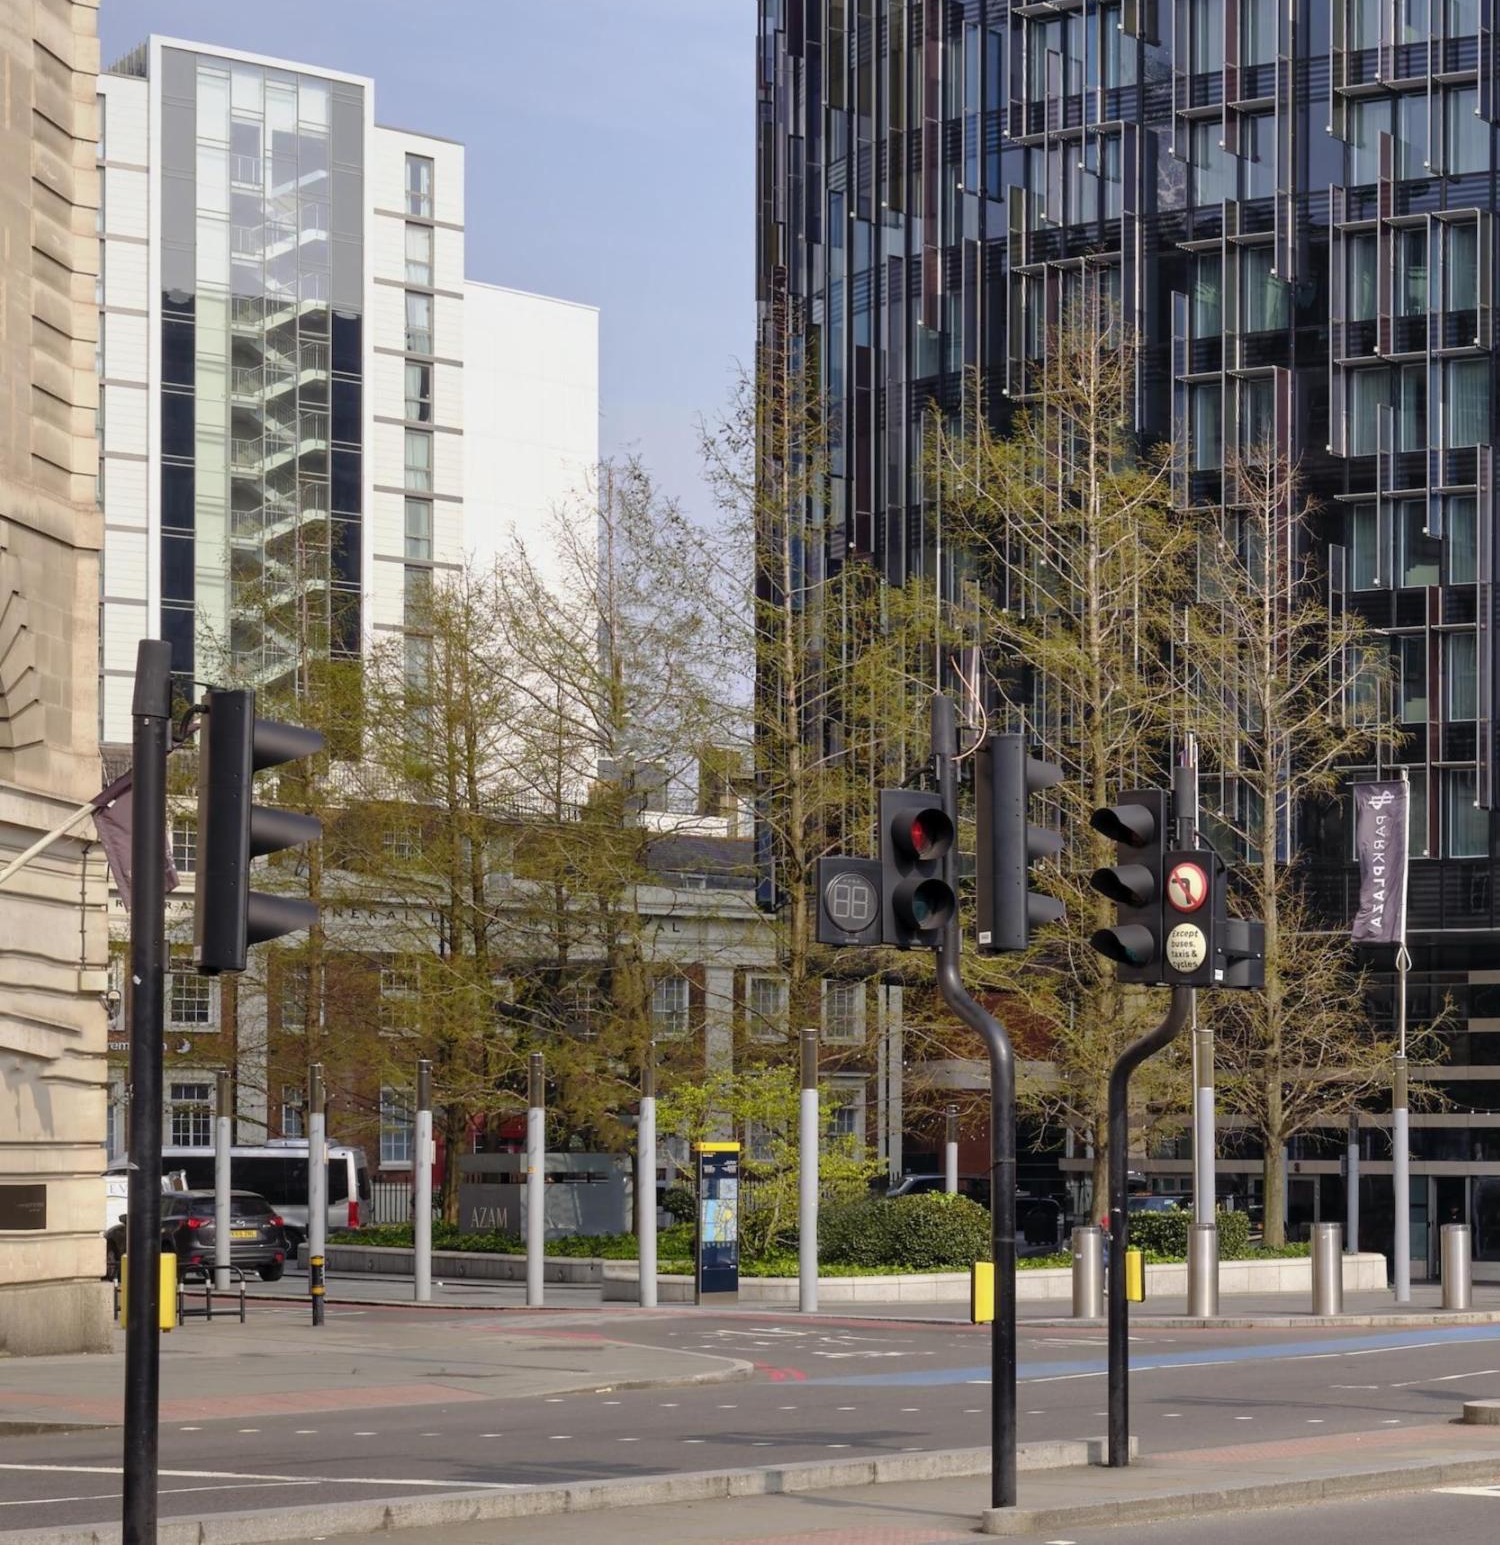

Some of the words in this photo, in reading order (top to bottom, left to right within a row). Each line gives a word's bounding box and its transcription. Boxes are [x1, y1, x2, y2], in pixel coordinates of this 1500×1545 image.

[1172, 929, 1198, 939] Except
[1171, 950, 1190, 958] taxis
[1191, 950, 1198, 958] &
[1173, 960, 1198, 969] cycles
